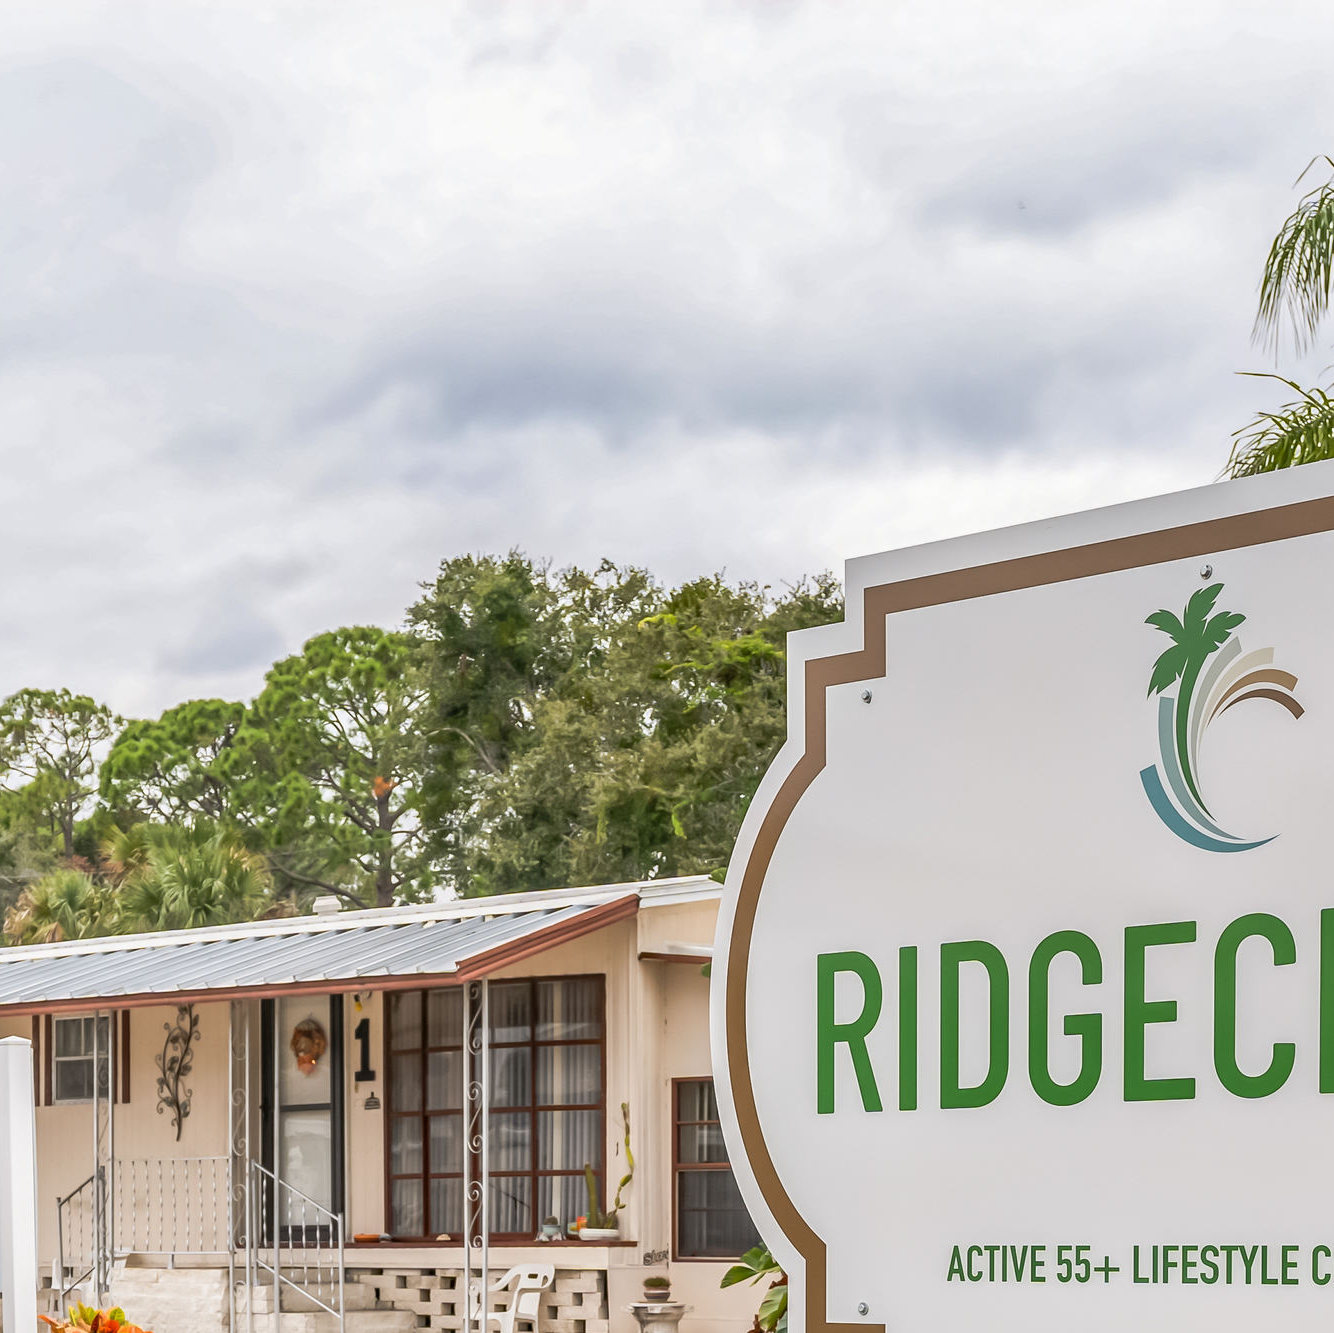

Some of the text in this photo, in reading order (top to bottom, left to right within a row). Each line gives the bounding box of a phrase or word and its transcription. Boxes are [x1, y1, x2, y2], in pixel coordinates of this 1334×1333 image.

[354, 1018, 376, 1081] 1
[947, 1244, 1047, 1283] ACTIVE
[1056, 1245, 1121, 1284] 55+
[1133, 1244, 1300, 1286] LIFESTYLE
